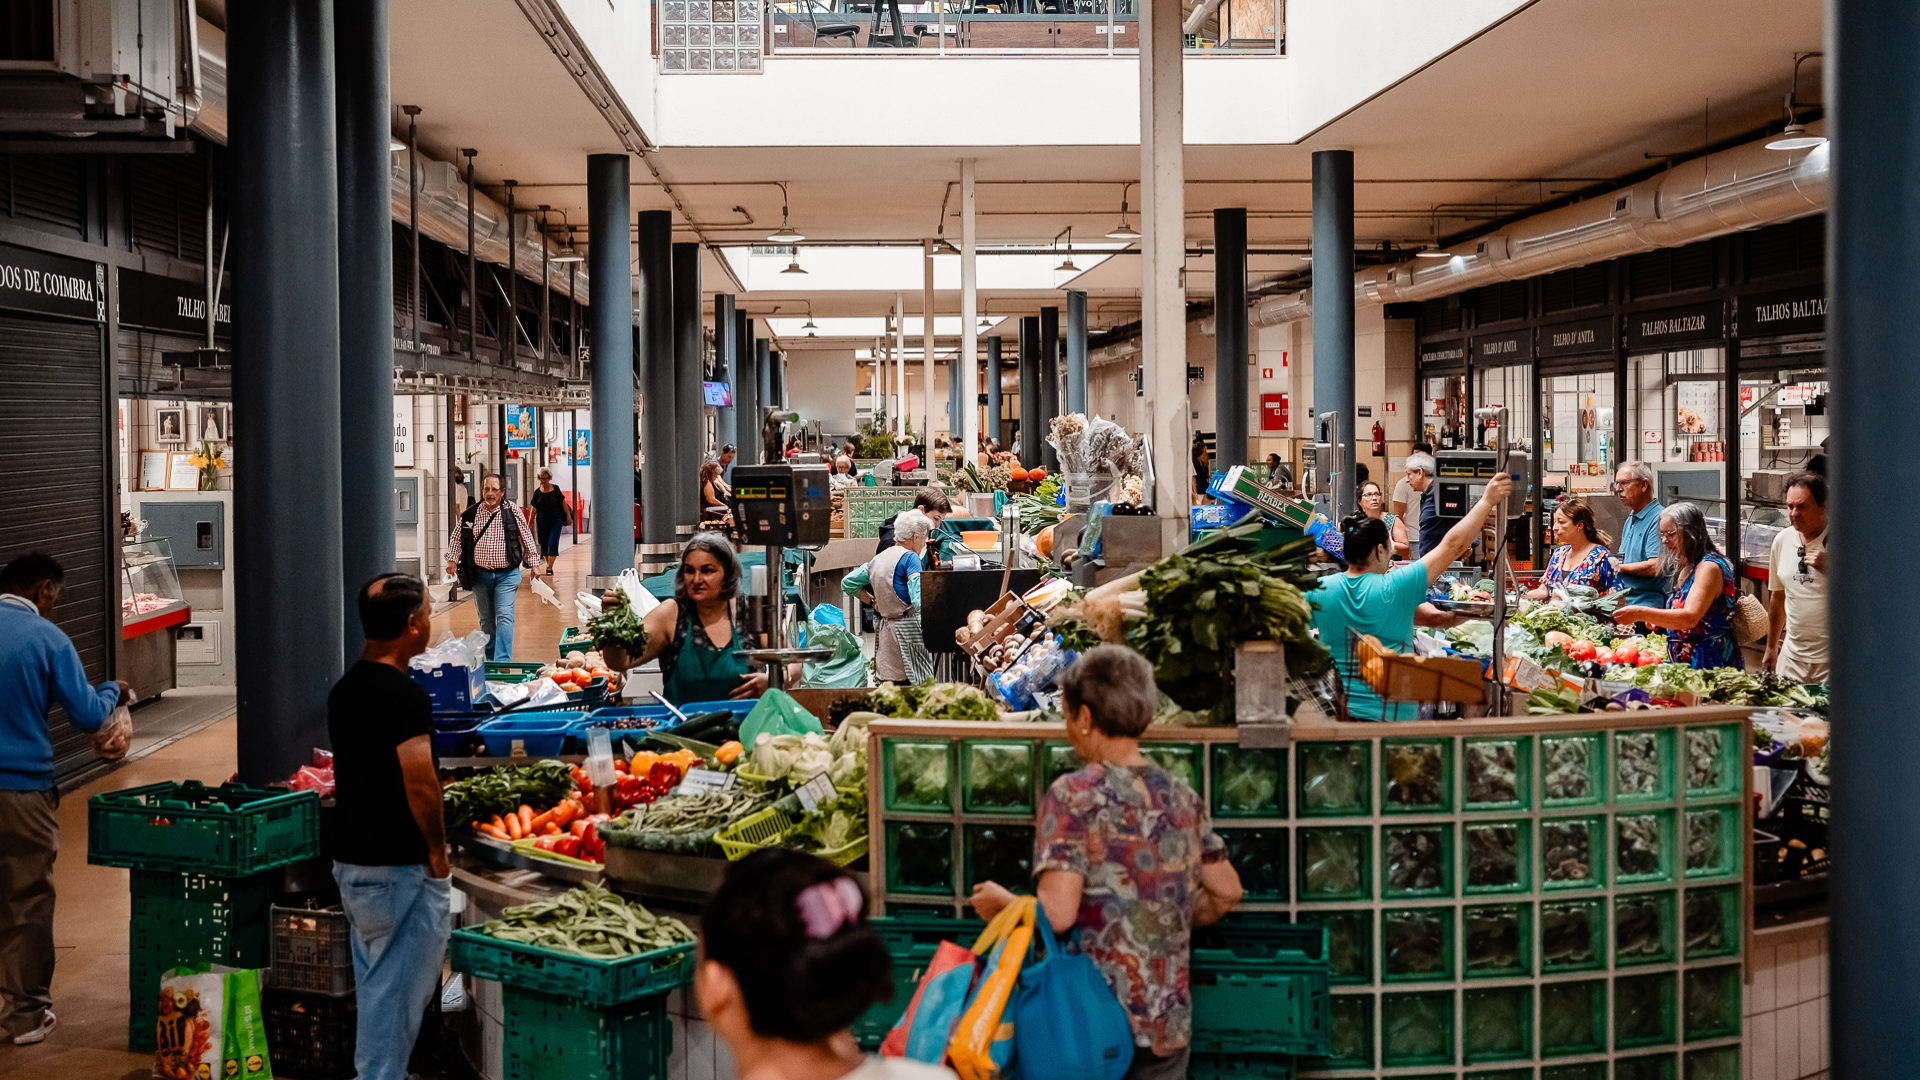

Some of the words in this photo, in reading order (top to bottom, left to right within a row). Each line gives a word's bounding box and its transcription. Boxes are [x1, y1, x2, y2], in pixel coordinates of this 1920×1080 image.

[24, 268, 41, 293] DE
[43, 272, 94, 302] COIMBRA
[177, 296, 206, 319] TALHO
[1756, 302, 1790, 322] TALHOS
[1642, 319, 1668, 336] TALHOS
[1669, 315, 1706, 333] BALTAZAR
[1483, 342, 1498, 355] TALHO
[1503, 340, 1517, 353] ANITA
[1553, 333, 1570, 347] TALHO
[1577, 330, 1595, 344] ANITA
